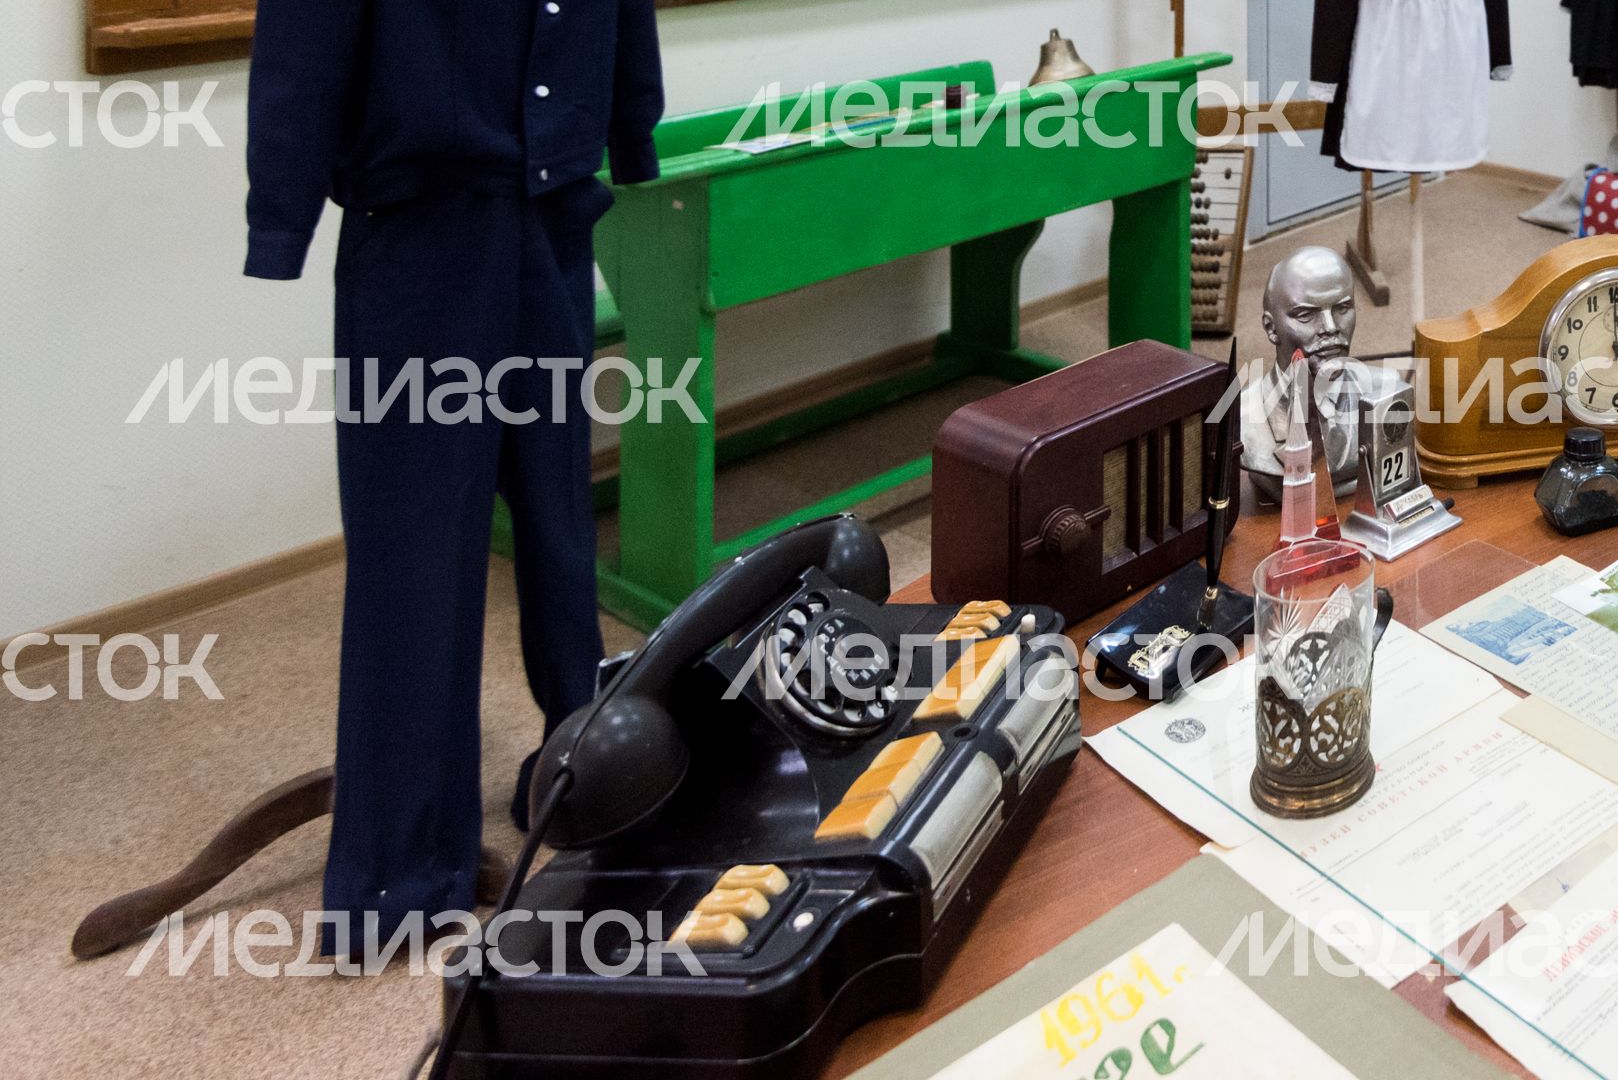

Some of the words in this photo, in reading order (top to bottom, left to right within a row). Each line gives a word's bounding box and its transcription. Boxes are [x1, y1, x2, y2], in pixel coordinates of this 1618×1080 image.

[1587, 296, 1598, 313] 11
[1567, 317, 1583, 334] 10
[1557, 345, 1569, 361] 9
[1567, 371, 1578, 387] 8
[1585, 387, 1597, 404] 7
[1383, 451, 1404, 487] 22
